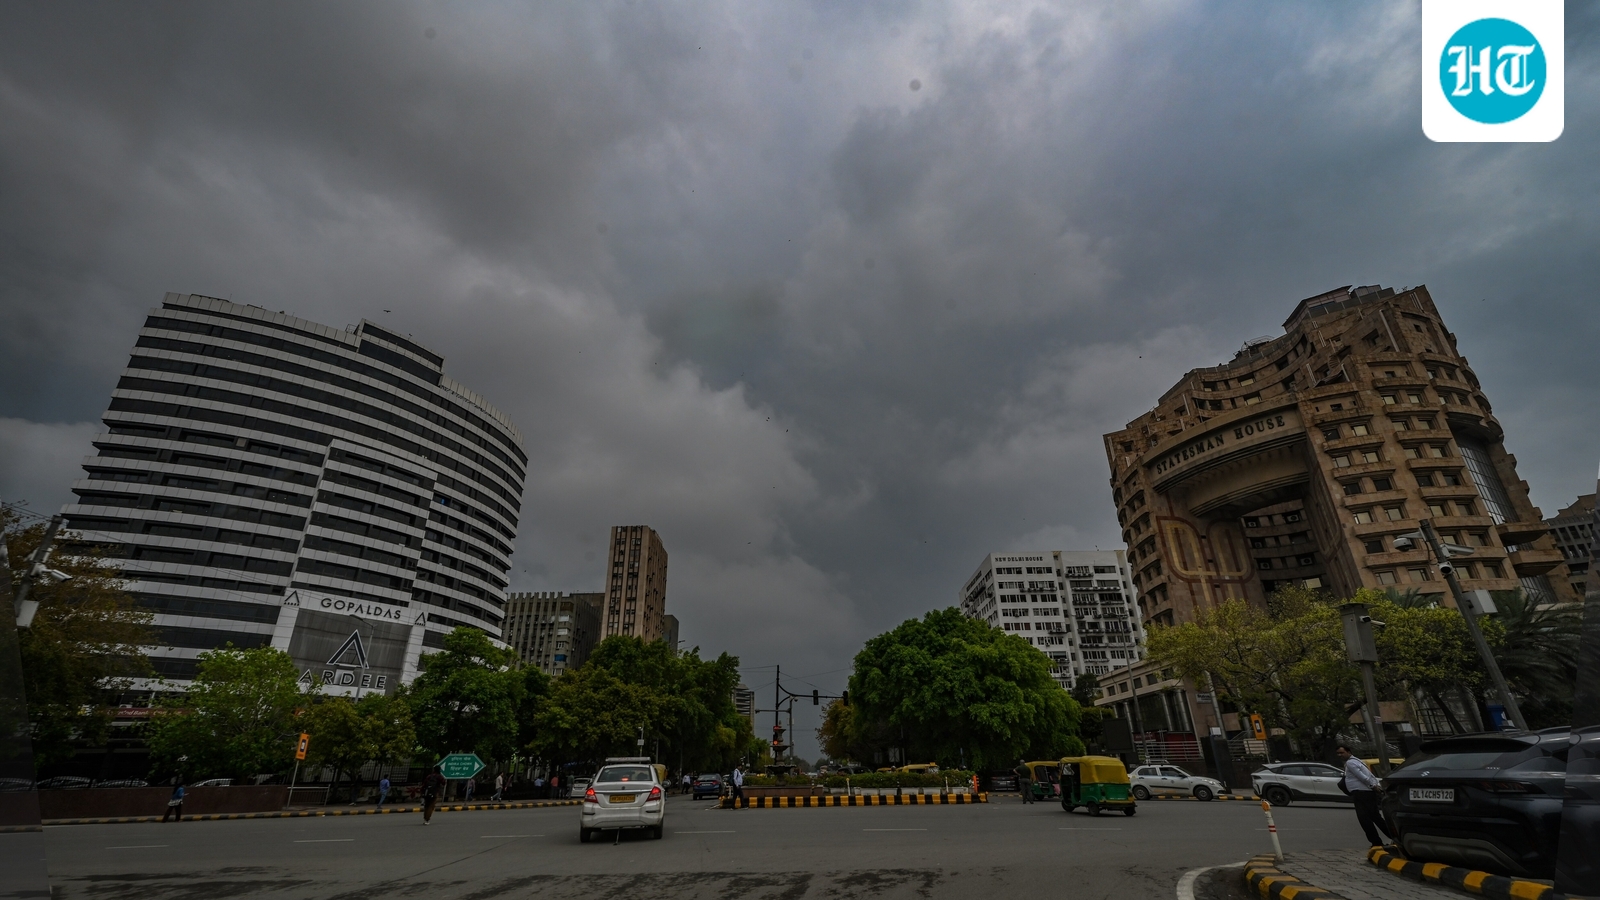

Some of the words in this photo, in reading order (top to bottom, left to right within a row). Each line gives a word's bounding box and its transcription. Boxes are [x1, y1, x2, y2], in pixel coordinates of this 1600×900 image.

[1156, 434, 1225, 475] STATESMAN
[1233, 415, 1286, 440] HOUSE
[320, 597, 402, 620] GOPALDAS
[297, 668, 387, 690] ARDEE
